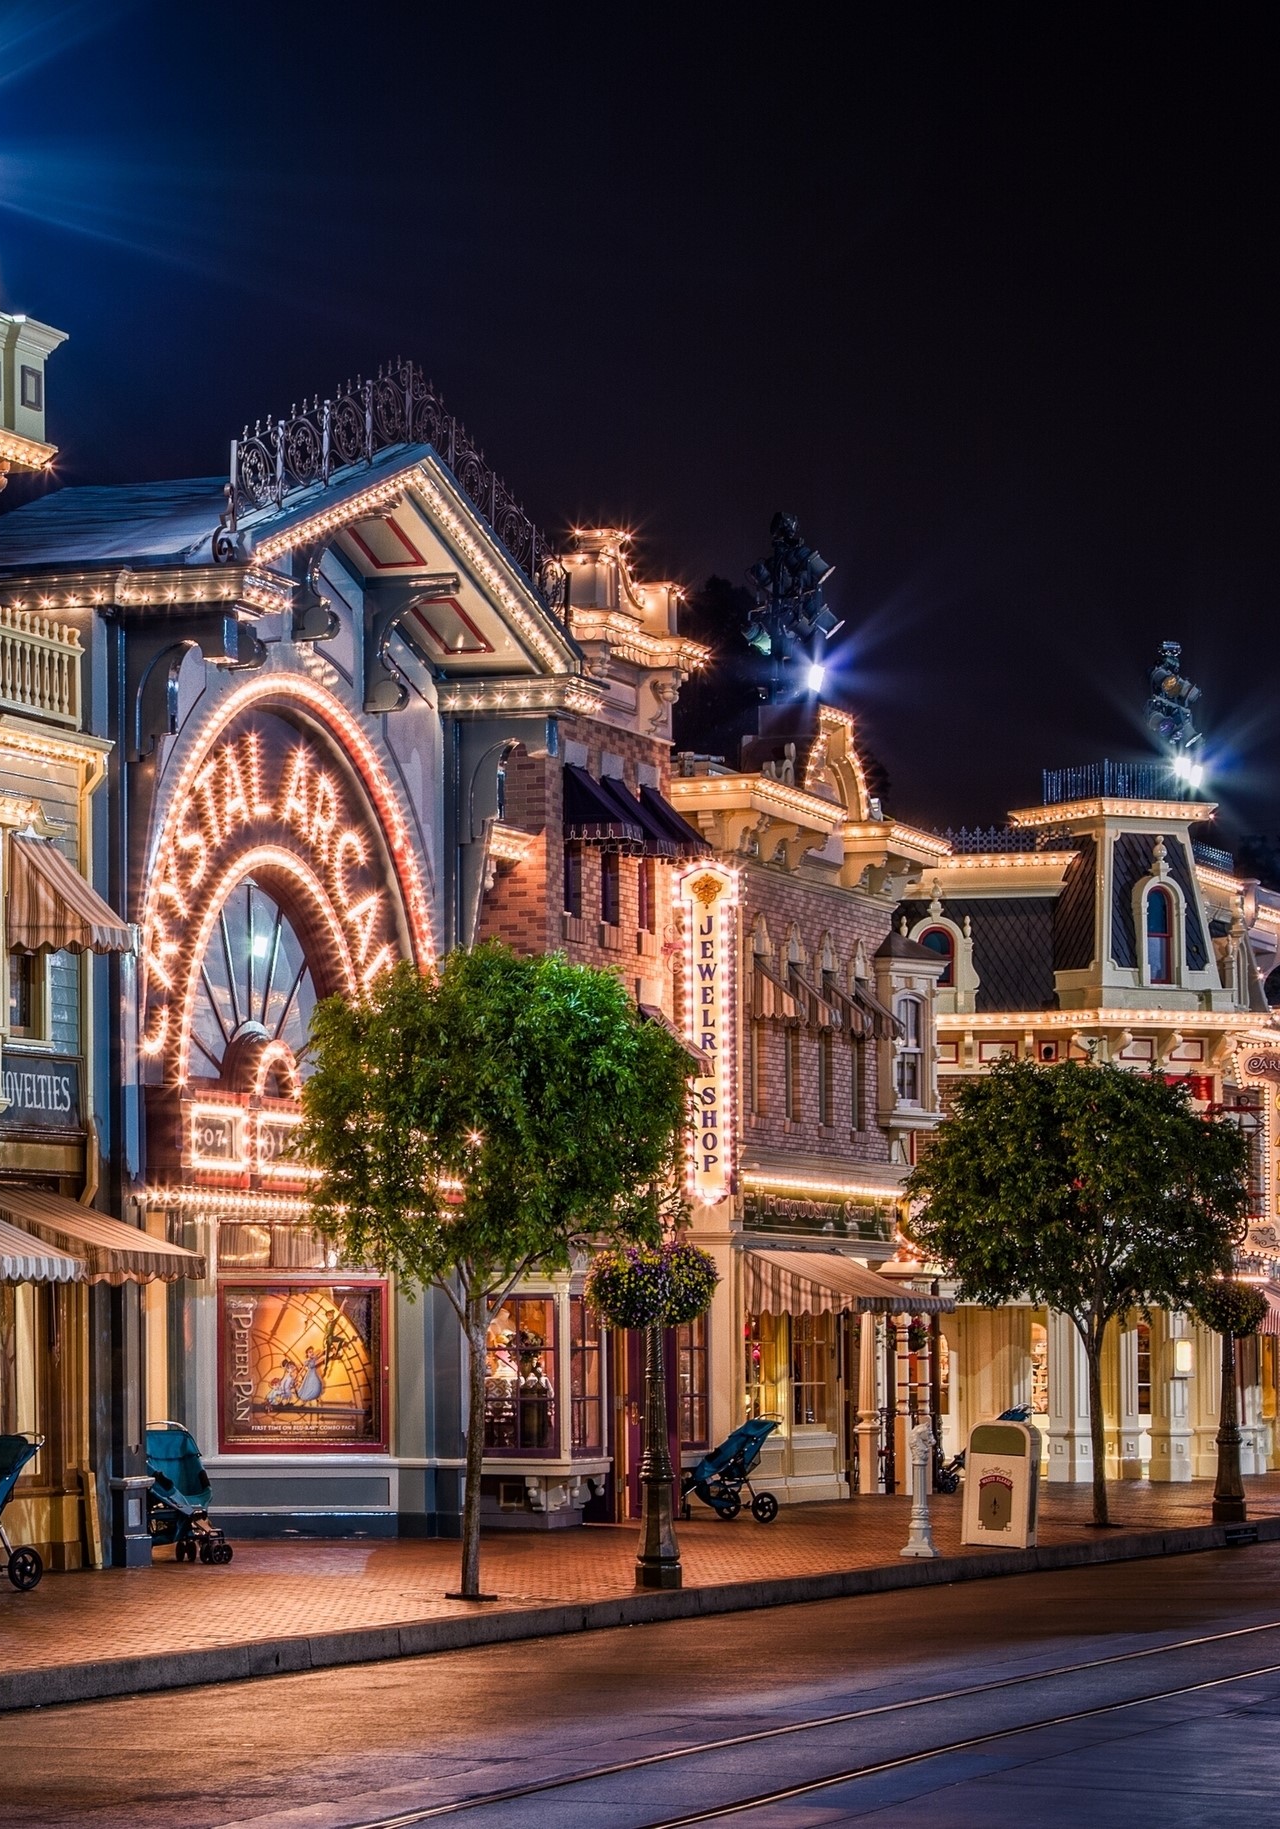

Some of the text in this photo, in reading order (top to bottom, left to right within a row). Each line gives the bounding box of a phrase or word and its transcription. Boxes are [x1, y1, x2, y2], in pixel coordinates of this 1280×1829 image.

[282, 746, 394, 1003] ARCA
[697, 914, 718, 1077] JEWELR
[1244, 1056, 1280, 1076] CAR
[701, 1087, 718, 1173] SHOP
[232, 1310, 254, 1422] PETER PAN
